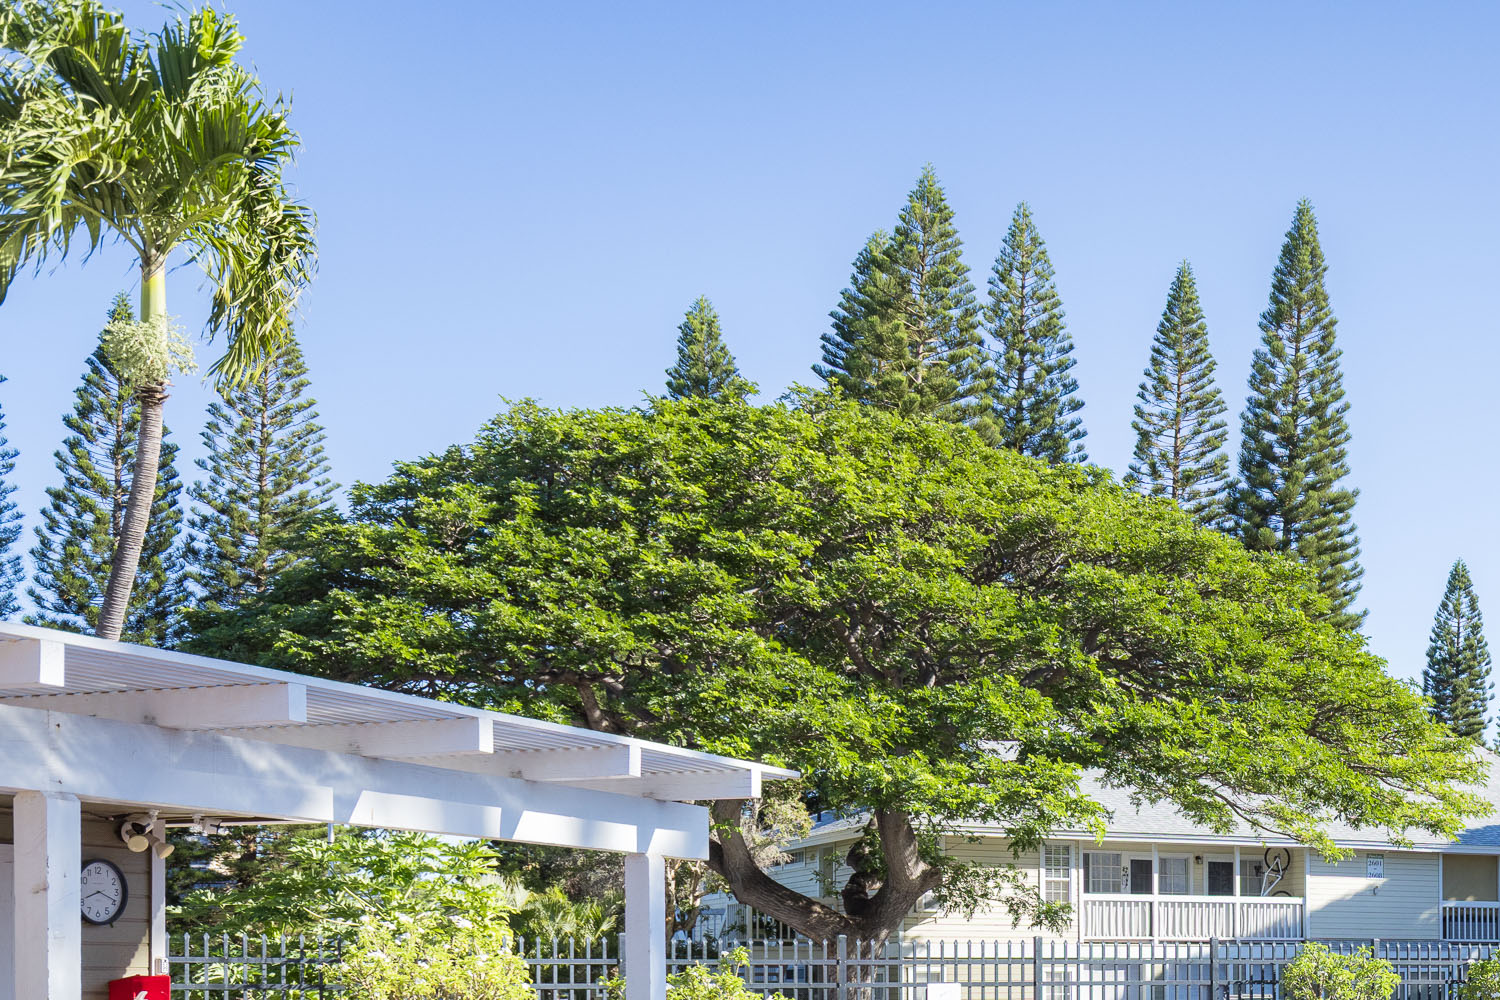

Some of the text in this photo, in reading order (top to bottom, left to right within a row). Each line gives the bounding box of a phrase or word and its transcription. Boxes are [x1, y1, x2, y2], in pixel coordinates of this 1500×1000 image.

[87, 869, 91, 877] 11
[95, 866, 102, 875] 12
[112, 878, 117, 886] 2
[114, 889, 119, 897] 3
[87, 907, 92, 915] 7
[96, 909, 101, 918] 6
[105, 907, 110, 915] 5
